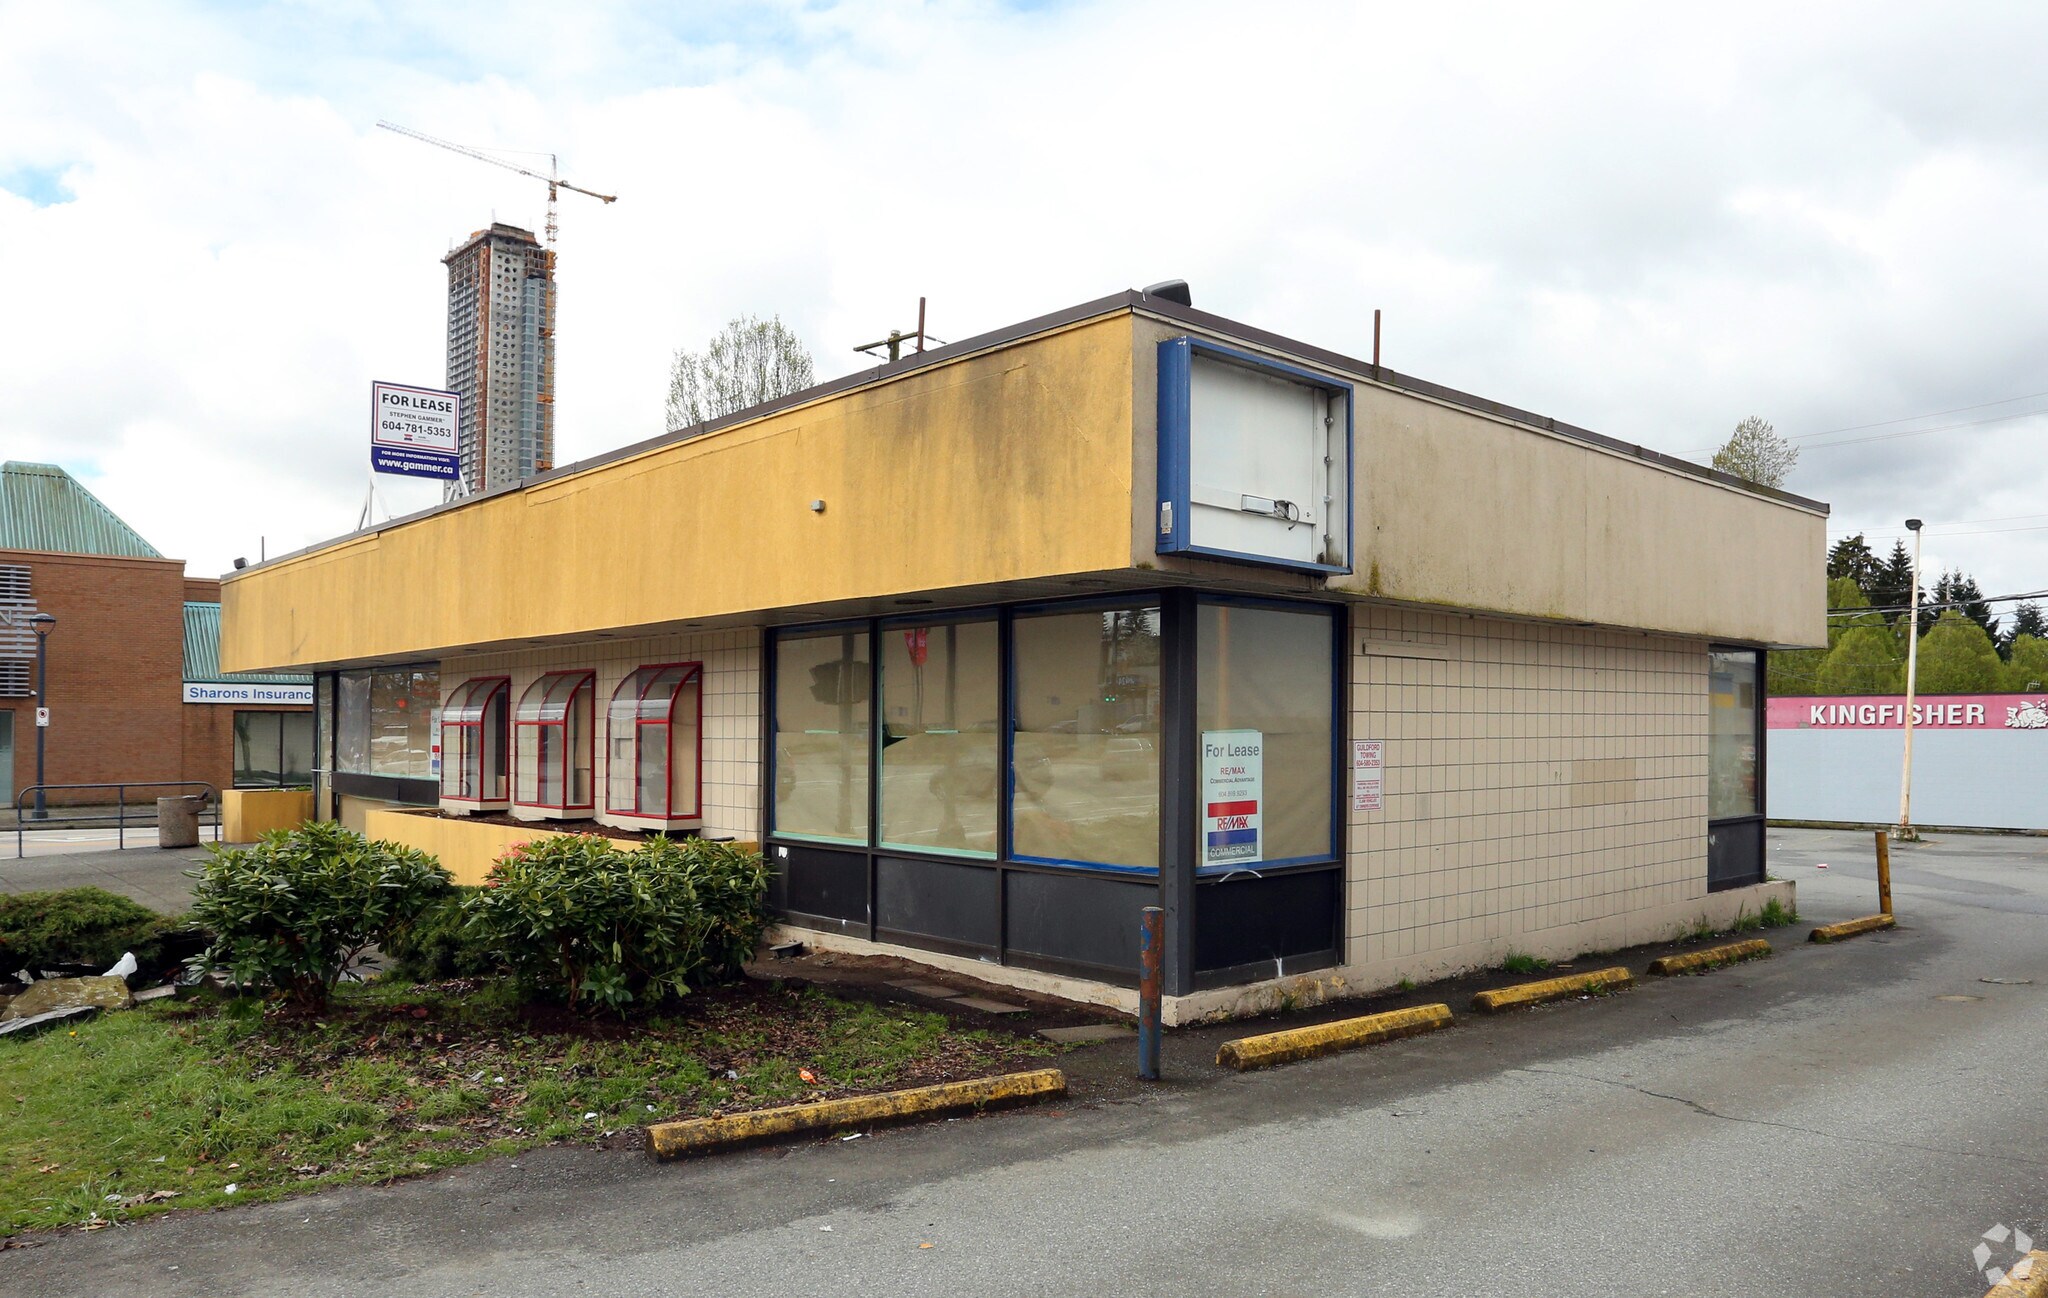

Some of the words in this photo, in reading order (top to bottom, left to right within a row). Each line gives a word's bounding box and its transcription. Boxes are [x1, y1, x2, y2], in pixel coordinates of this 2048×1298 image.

[382, 393, 409, 406] FOR
[412, 397, 452, 412] LEASE
[389, 411, 417, 420] STEPHEN
[382, 420, 452, 438] 604-781-5353
[406, 453, 437, 461] INFORMATION
[378, 459, 453, 473] www.gammer.ca
[190, 687, 248, 698] Sharons
[254, 689, 313, 699] Insuranc
[1809, 703, 1986, 725] KINGFISHER
[1205, 743, 1225, 758] For
[1227, 743, 1260, 757] Lease
[1220, 766, 1246, 776] RE/MAX
[1217, 815, 1249, 831] RE/MAX
[1210, 845, 1256, 858] COMMERCIAL
